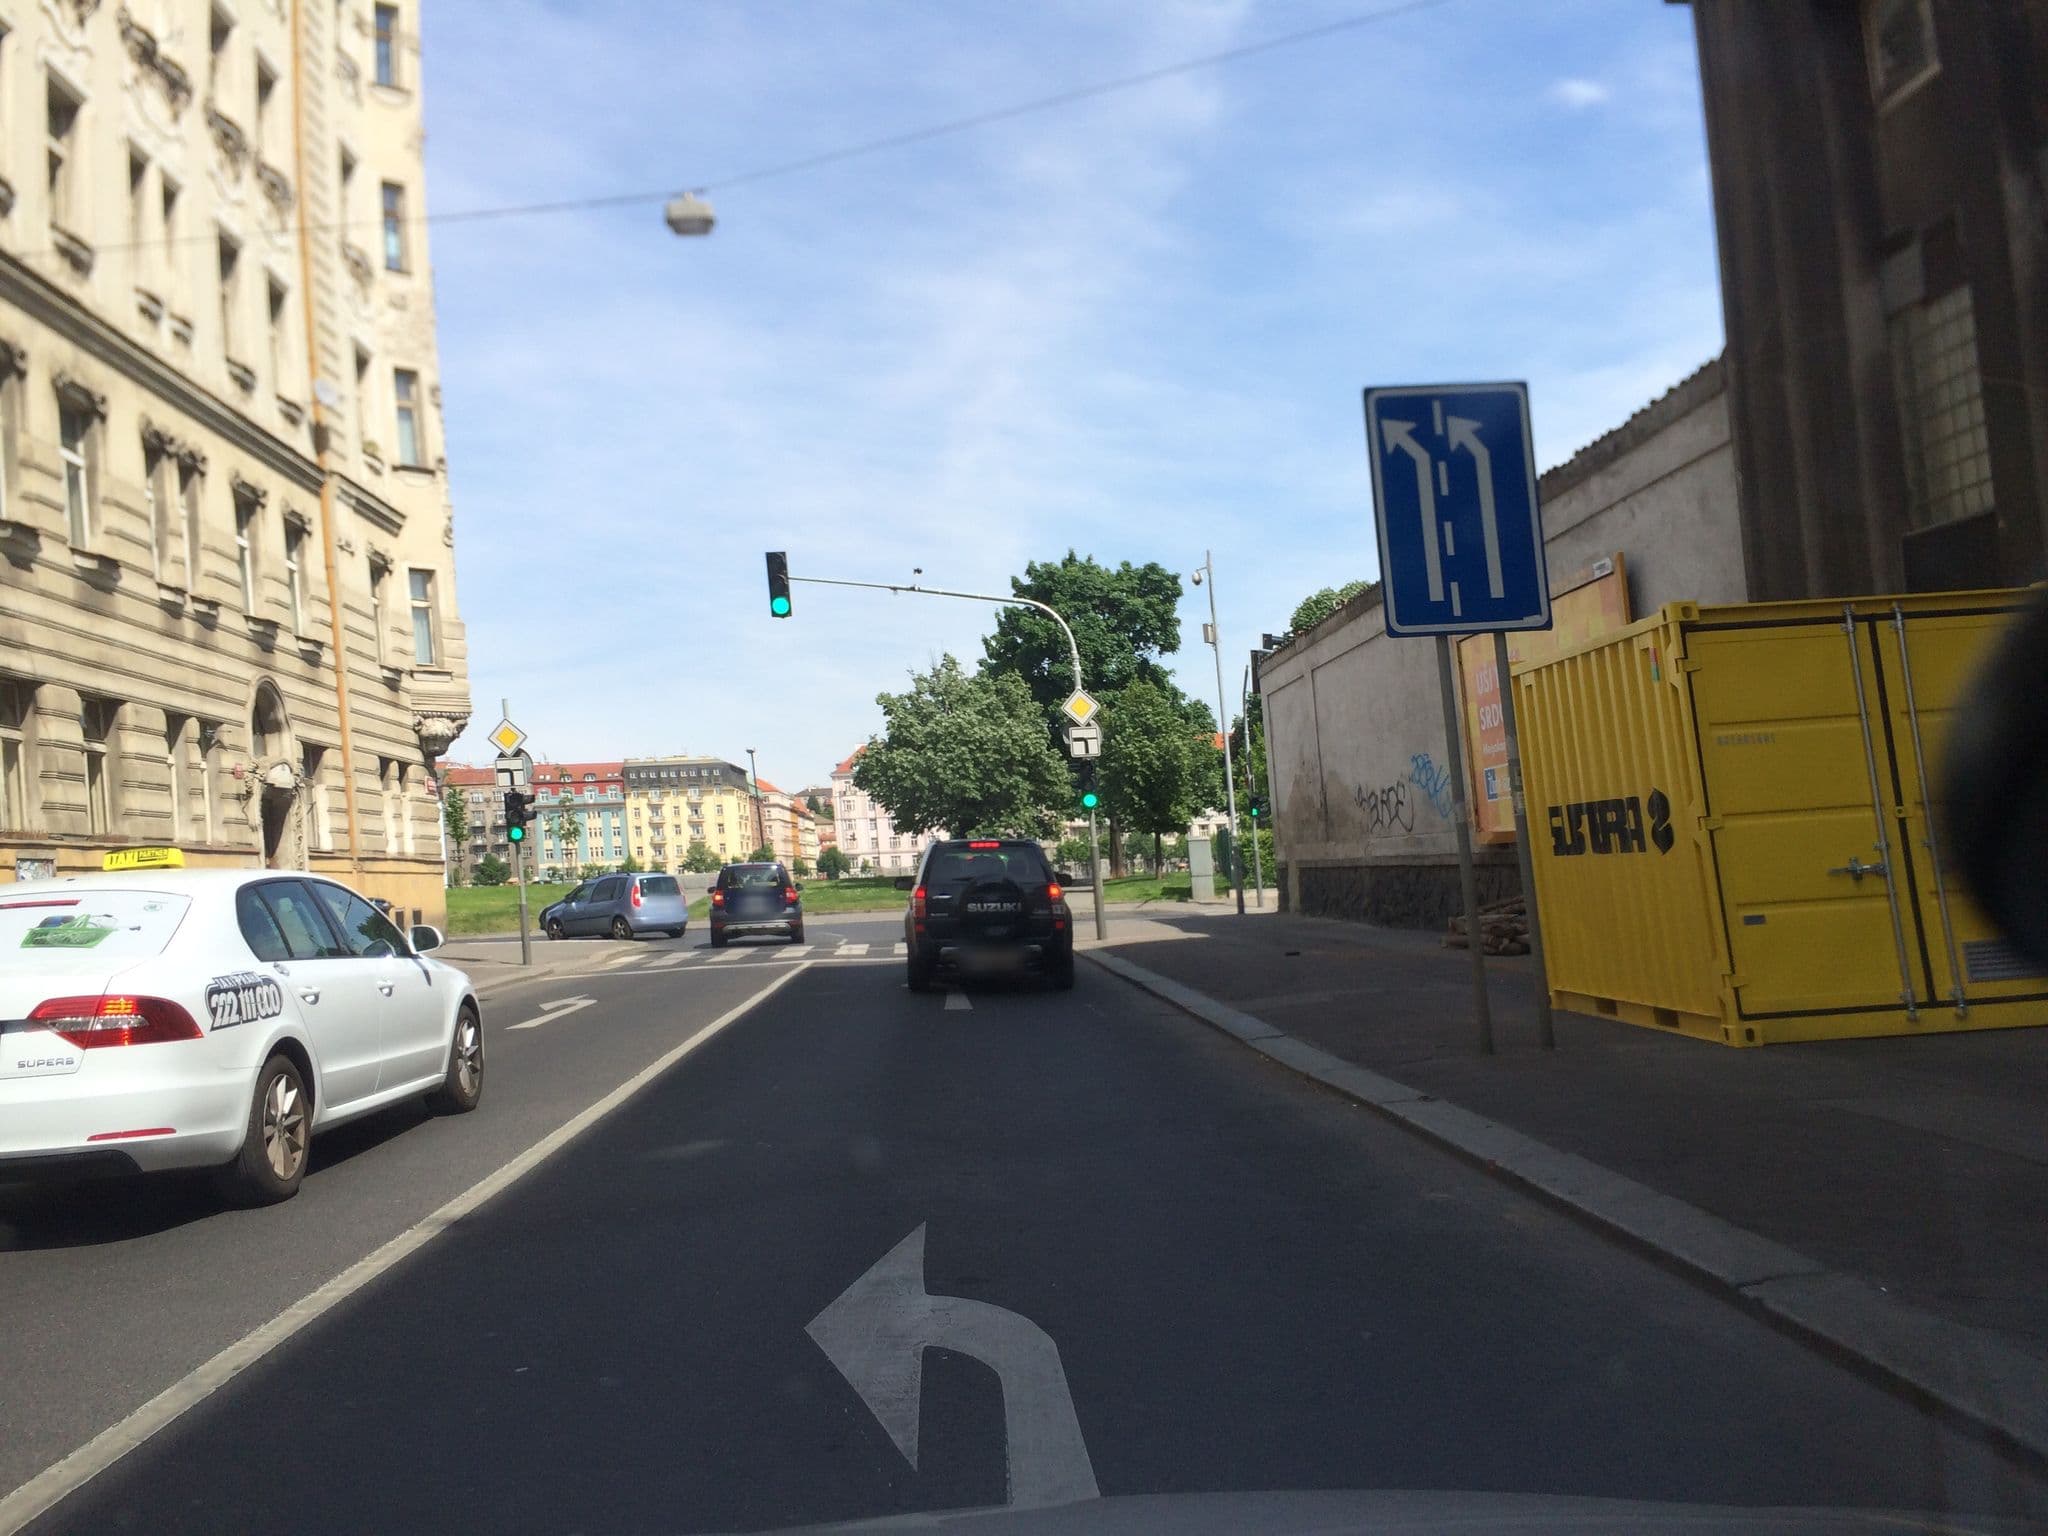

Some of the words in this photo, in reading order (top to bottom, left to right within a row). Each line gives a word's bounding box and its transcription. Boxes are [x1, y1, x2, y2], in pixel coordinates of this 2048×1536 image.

[109, 851, 136, 865] TAXI
[967, 902, 1022, 913] SUZUKI
[211, 991, 240, 1028] 222
[238, 987, 257, 1021] 111
[256, 984, 281, 1017] 000
[18, 1057, 74, 1068] SUPERB
